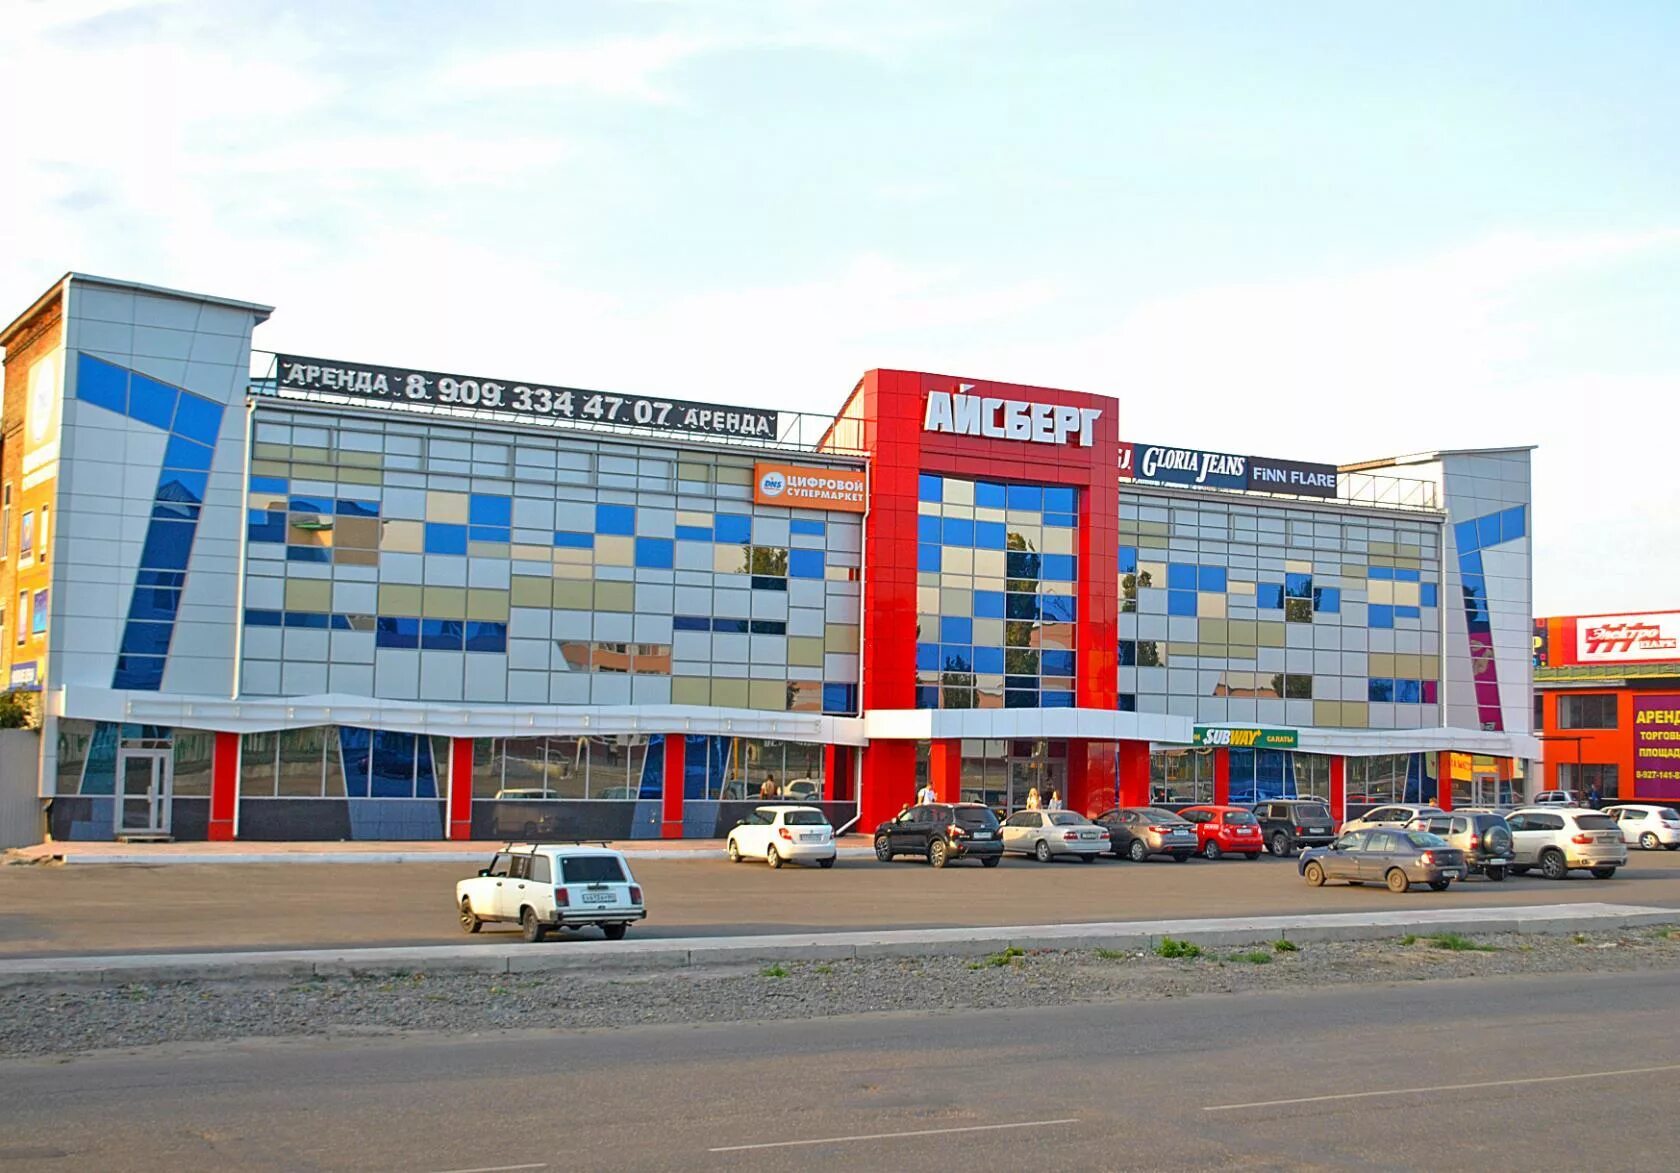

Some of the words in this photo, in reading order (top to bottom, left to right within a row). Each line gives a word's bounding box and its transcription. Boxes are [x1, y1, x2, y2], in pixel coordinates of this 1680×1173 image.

[288, 363, 389, 394] АРЕНДА
[405, 374, 427, 400] 8
[438, 377, 501, 408] 909
[511, 385, 574, 416] 334
[583, 394, 623, 420] 47
[633, 399, 673, 425] 07
[684, 407, 770, 434] АРЕНДА
[924, 383, 1103, 447] АЙСБЕРГ
[764, 479, 783, 489] DNS
[786, 475, 864, 492] ЦИФРОВОЙ
[1290, 471, 1336, 488] FLARE
[786, 488, 864, 502] СУПЕРМАРКЕТ
[1202, 728, 1262, 746] SUBWAY
